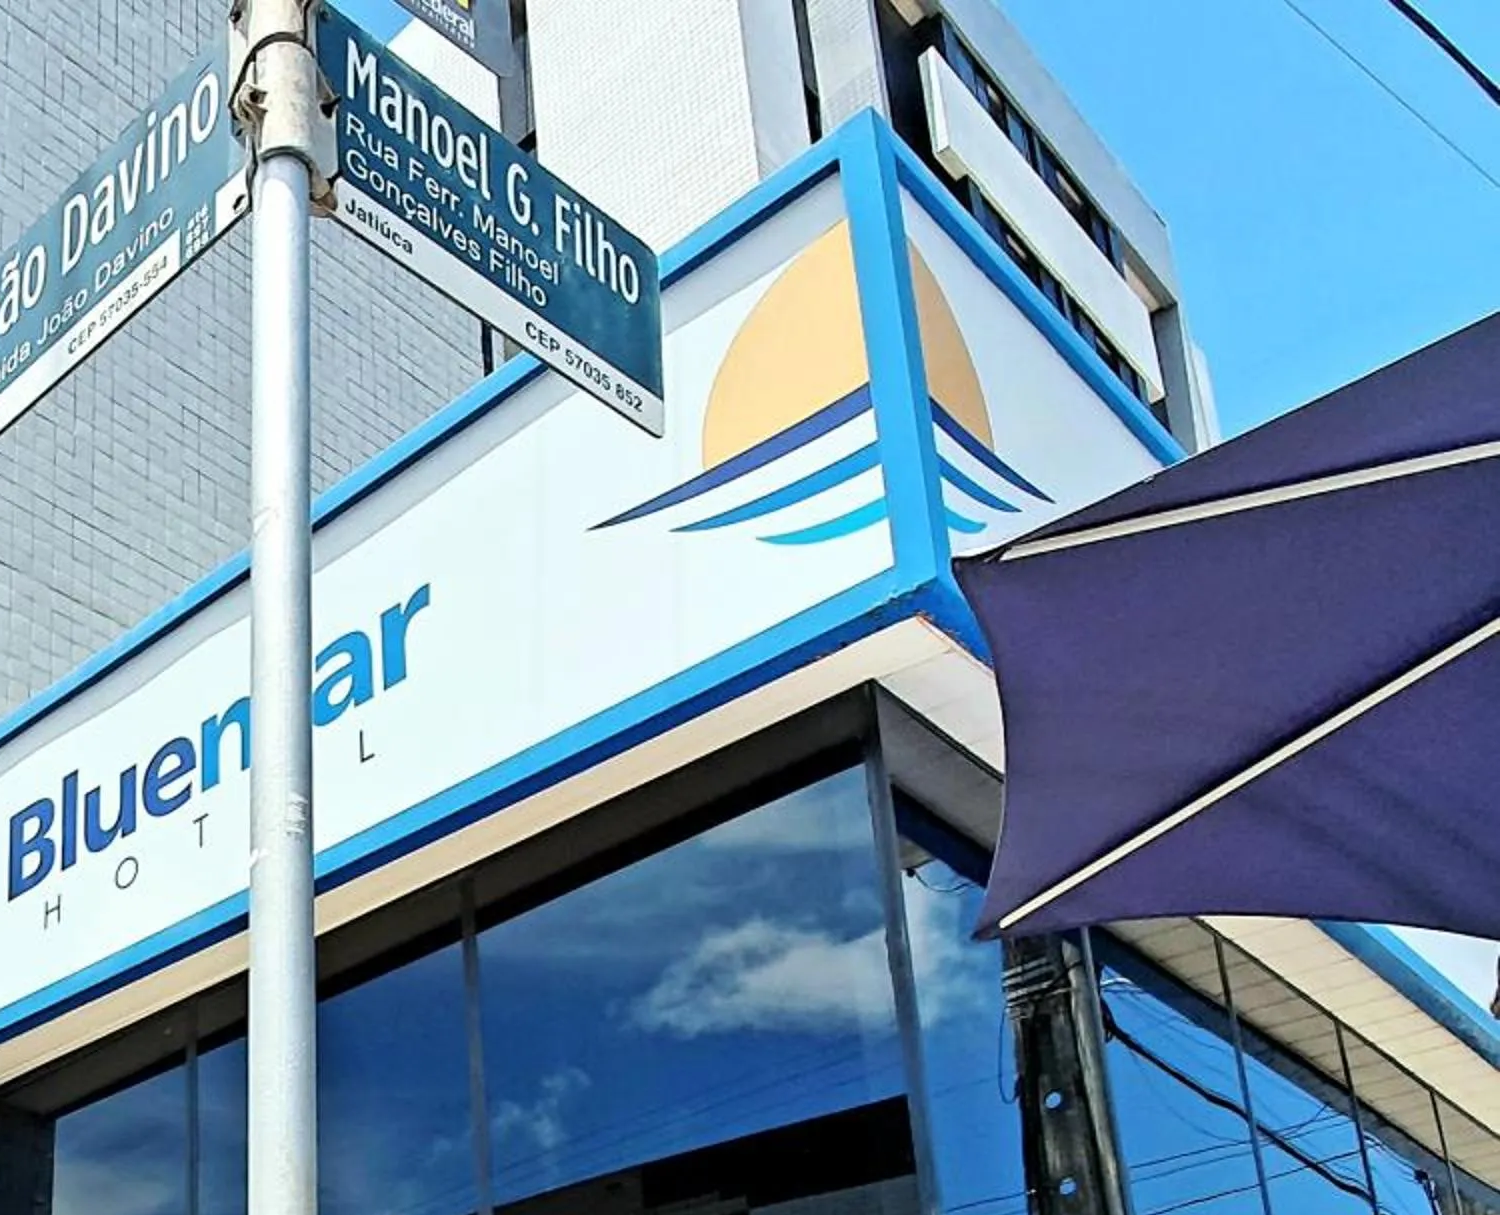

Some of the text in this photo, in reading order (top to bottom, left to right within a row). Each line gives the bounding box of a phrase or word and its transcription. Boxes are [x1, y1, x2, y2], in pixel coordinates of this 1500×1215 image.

[61, 72, 219, 276] Davino
[345, 112, 560, 285] Rua Ferr. Manoel
[345, 199, 413, 255] Jatiúca
[345, 149, 547, 307] Gonçalves Filho
[347, 37, 640, 304] Manoel G. Filho
[37, 289, 88, 345] João
[94, 207, 173, 292] Davino
[67, 255, 168, 354] CEP 57035-554
[525, 321, 560, 352] CEP
[565, 349, 611, 391] 57035
[43, 729, 375, 930] HOTL
